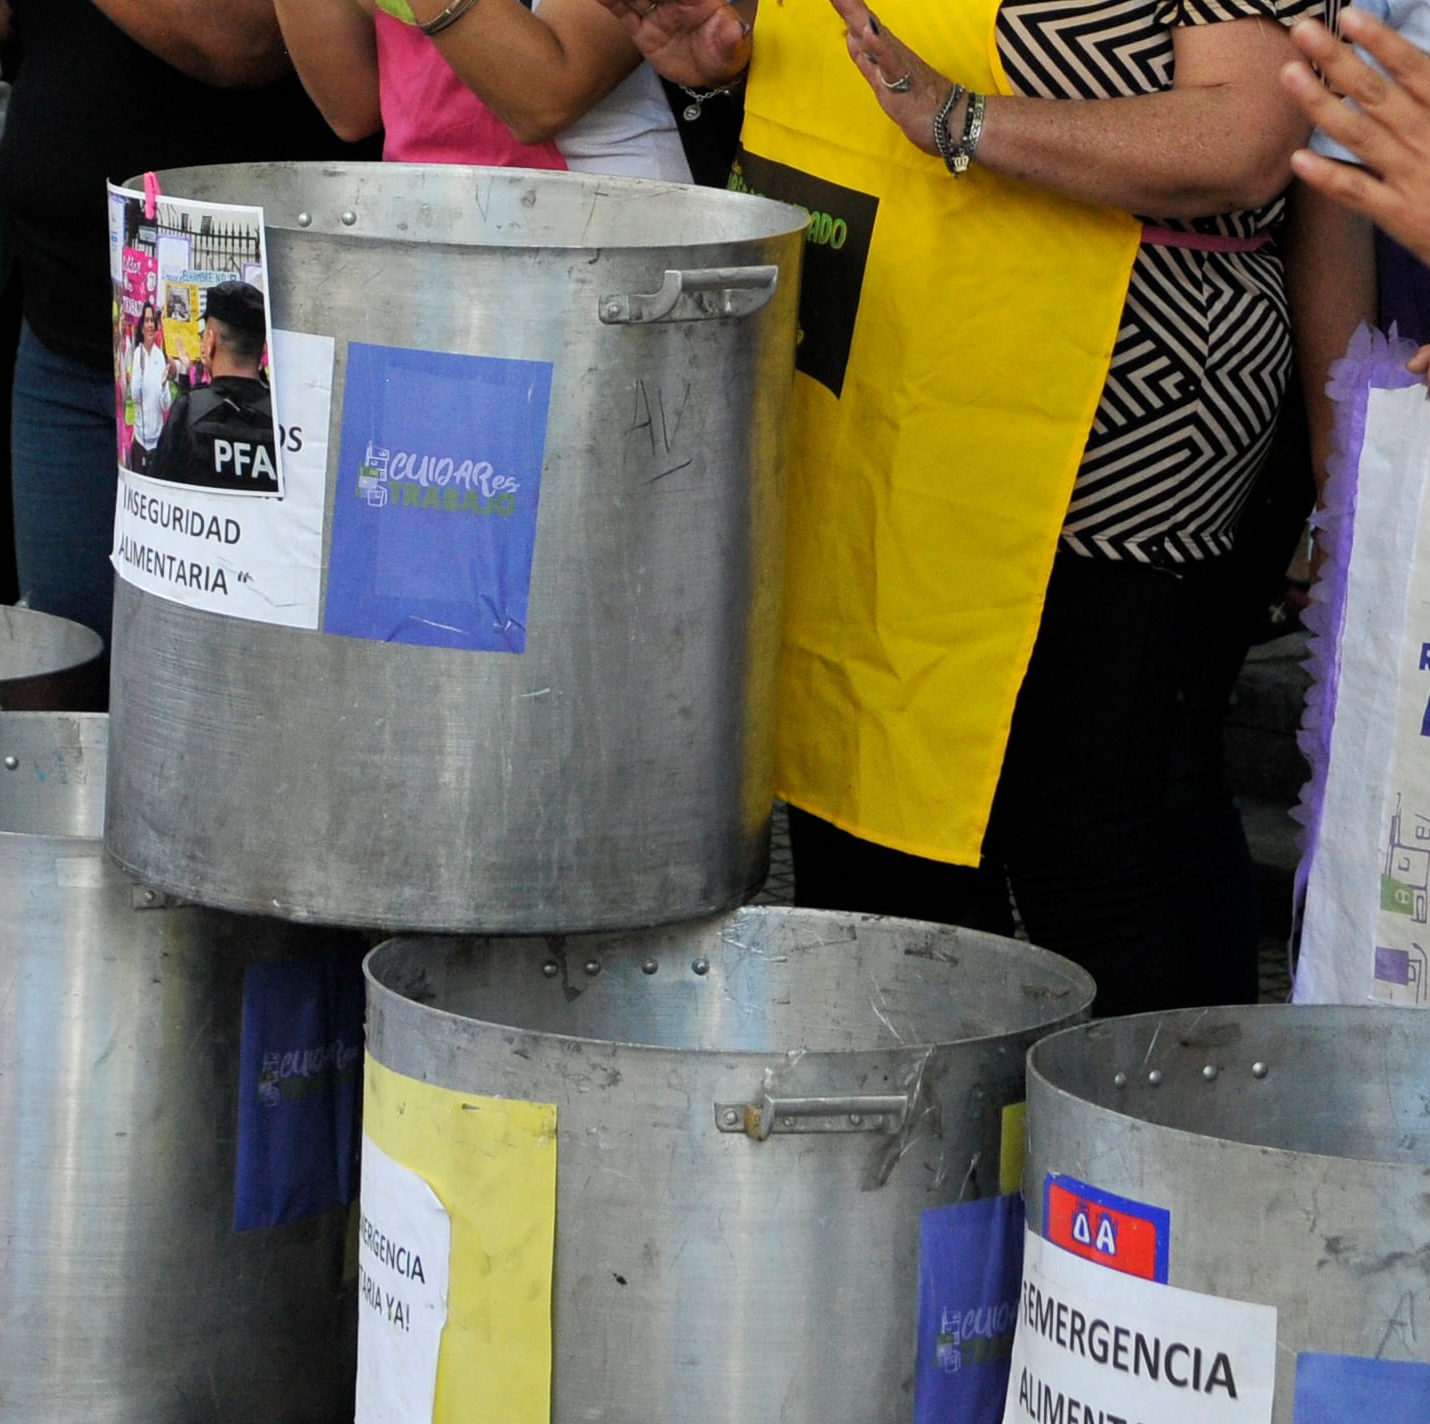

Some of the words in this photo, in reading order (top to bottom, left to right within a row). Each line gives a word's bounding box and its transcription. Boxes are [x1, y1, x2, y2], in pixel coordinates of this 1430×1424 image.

[213, 438, 277, 481] PFA
[389, 452, 495, 498] CUIDAR
[491, 475, 520, 494] es
[122, 483, 242, 545] INSEGURIDAD
[388, 481, 516, 517] TRABAJO
[359, 1214, 426, 1286] ERGENCIA
[385, 1291, 410, 1333] YA!
